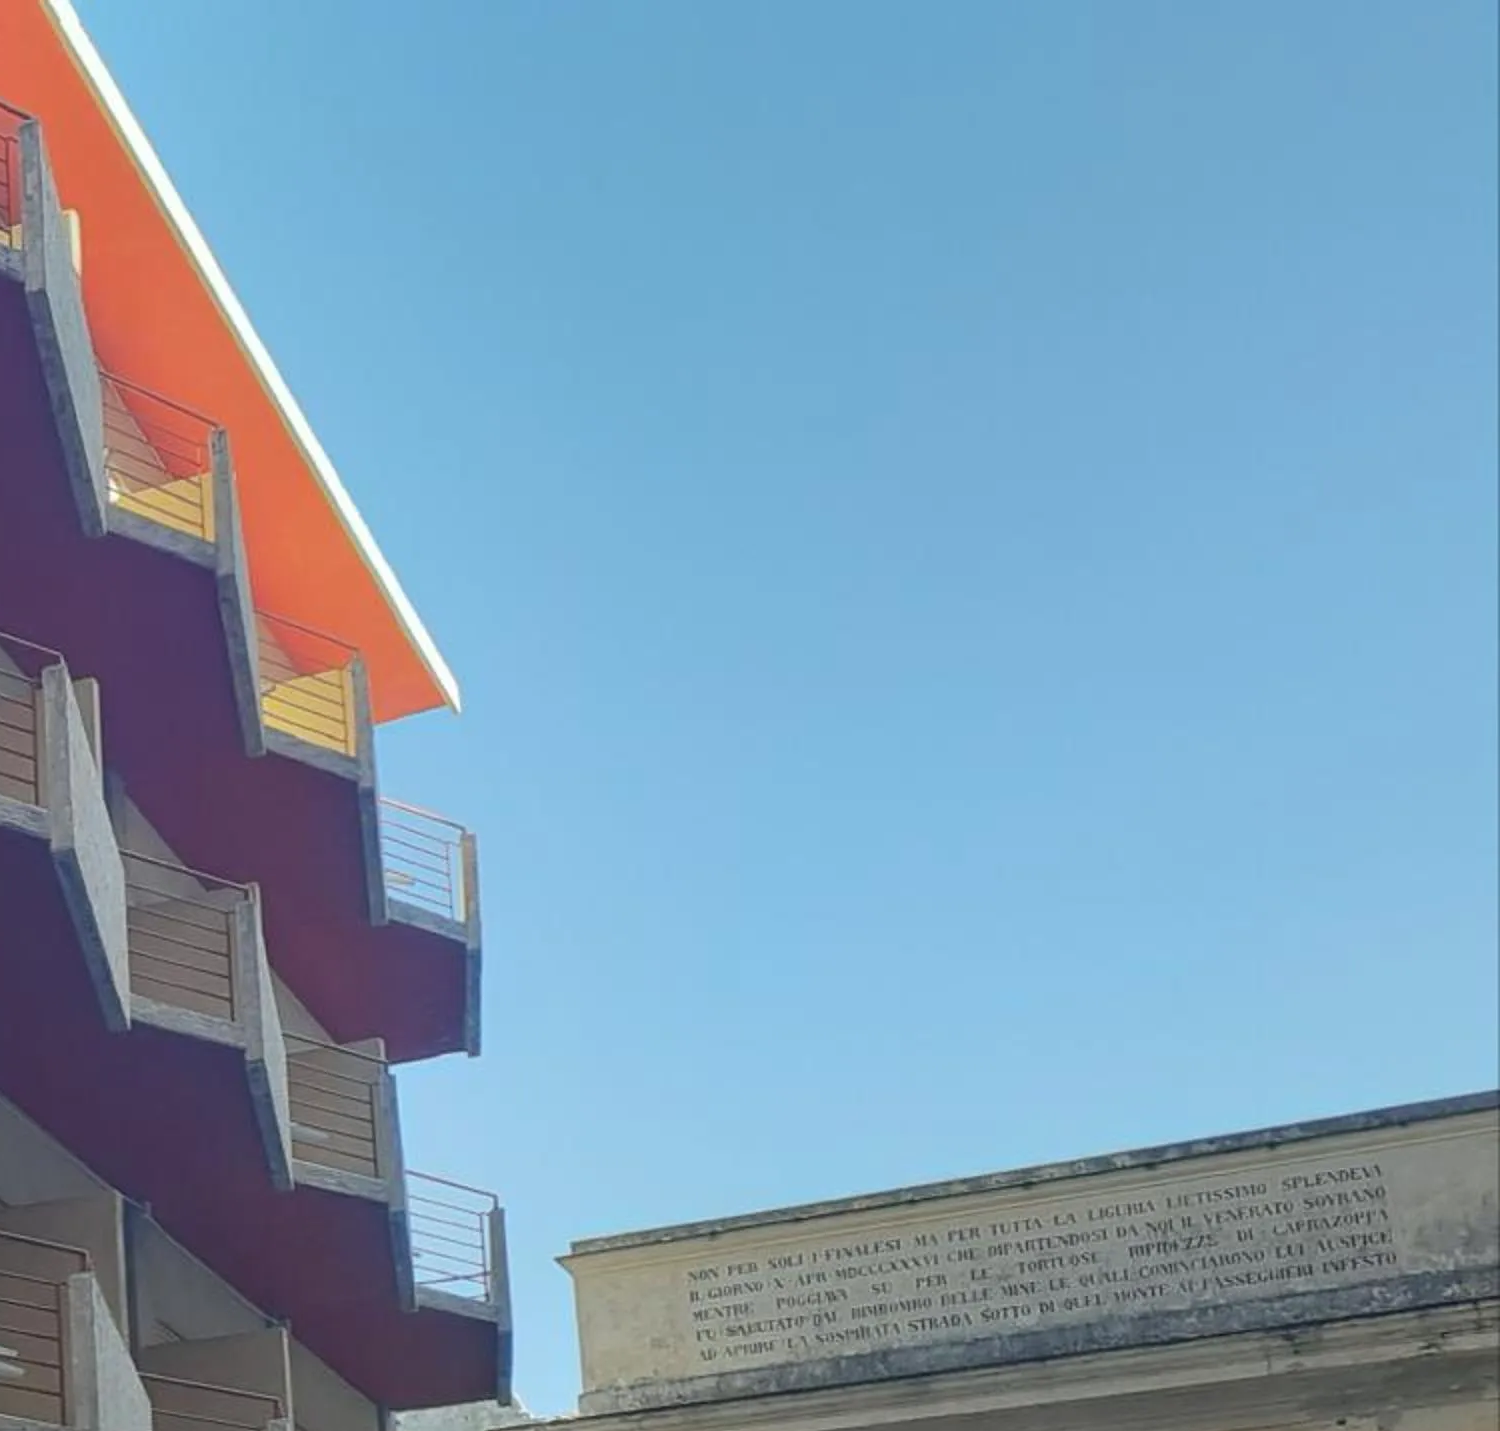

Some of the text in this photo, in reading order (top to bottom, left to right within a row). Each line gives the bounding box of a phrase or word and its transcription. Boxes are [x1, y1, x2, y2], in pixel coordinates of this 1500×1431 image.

[687, 1267, 720, 1282] NON
[726, 1261, 759, 1277] PER
[767, 1252, 804, 1270] SOLI
[823, 1238, 902, 1262] FINALESI
[913, 1233, 939, 1249] MA
[947, 1226, 981, 1243] PER
[989, 1216, 1044, 1237] TUTTA
[1053, 1212, 1077, 1227] LA
[1087, 1199, 1156, 1222] LIGURIA
[1165, 1182, 1268, 1210] LIETISSIMO
[1280, 1163, 1383, 1193] SPLENDEVA
[692, 1302, 755, 1322] MENTRE
[870, 1281, 893, 1295] SU
[914, 1273, 948, 1290] PER
[969, 1266, 992, 1281] LE
[1235, 1227, 1254, 1243] DI
[1272, 1207, 1389, 1237] CAPRAZOPPA
[706, 1280, 765, 1300] GIORNO
[946, 1248, 976, 1264] CHE
[1115, 1223, 1140, 1240] DA
[1202, 1201, 1295, 1226] VENERATO
[1302, 1184, 1387, 1211] SOVRANO
[724, 1315, 806, 1338] SALUTATO
[939, 1286, 992, 1308] DELLE
[1048, 1276, 1070, 1292] LE
[1078, 1266, 1130, 1289] QUALI
[906, 1310, 973, 1333] STRADA
[979, 1302, 1032, 1323] SOTTO
[1038, 1299, 1055, 1315] DI
[1112, 1282, 1169, 1303] MONTE
